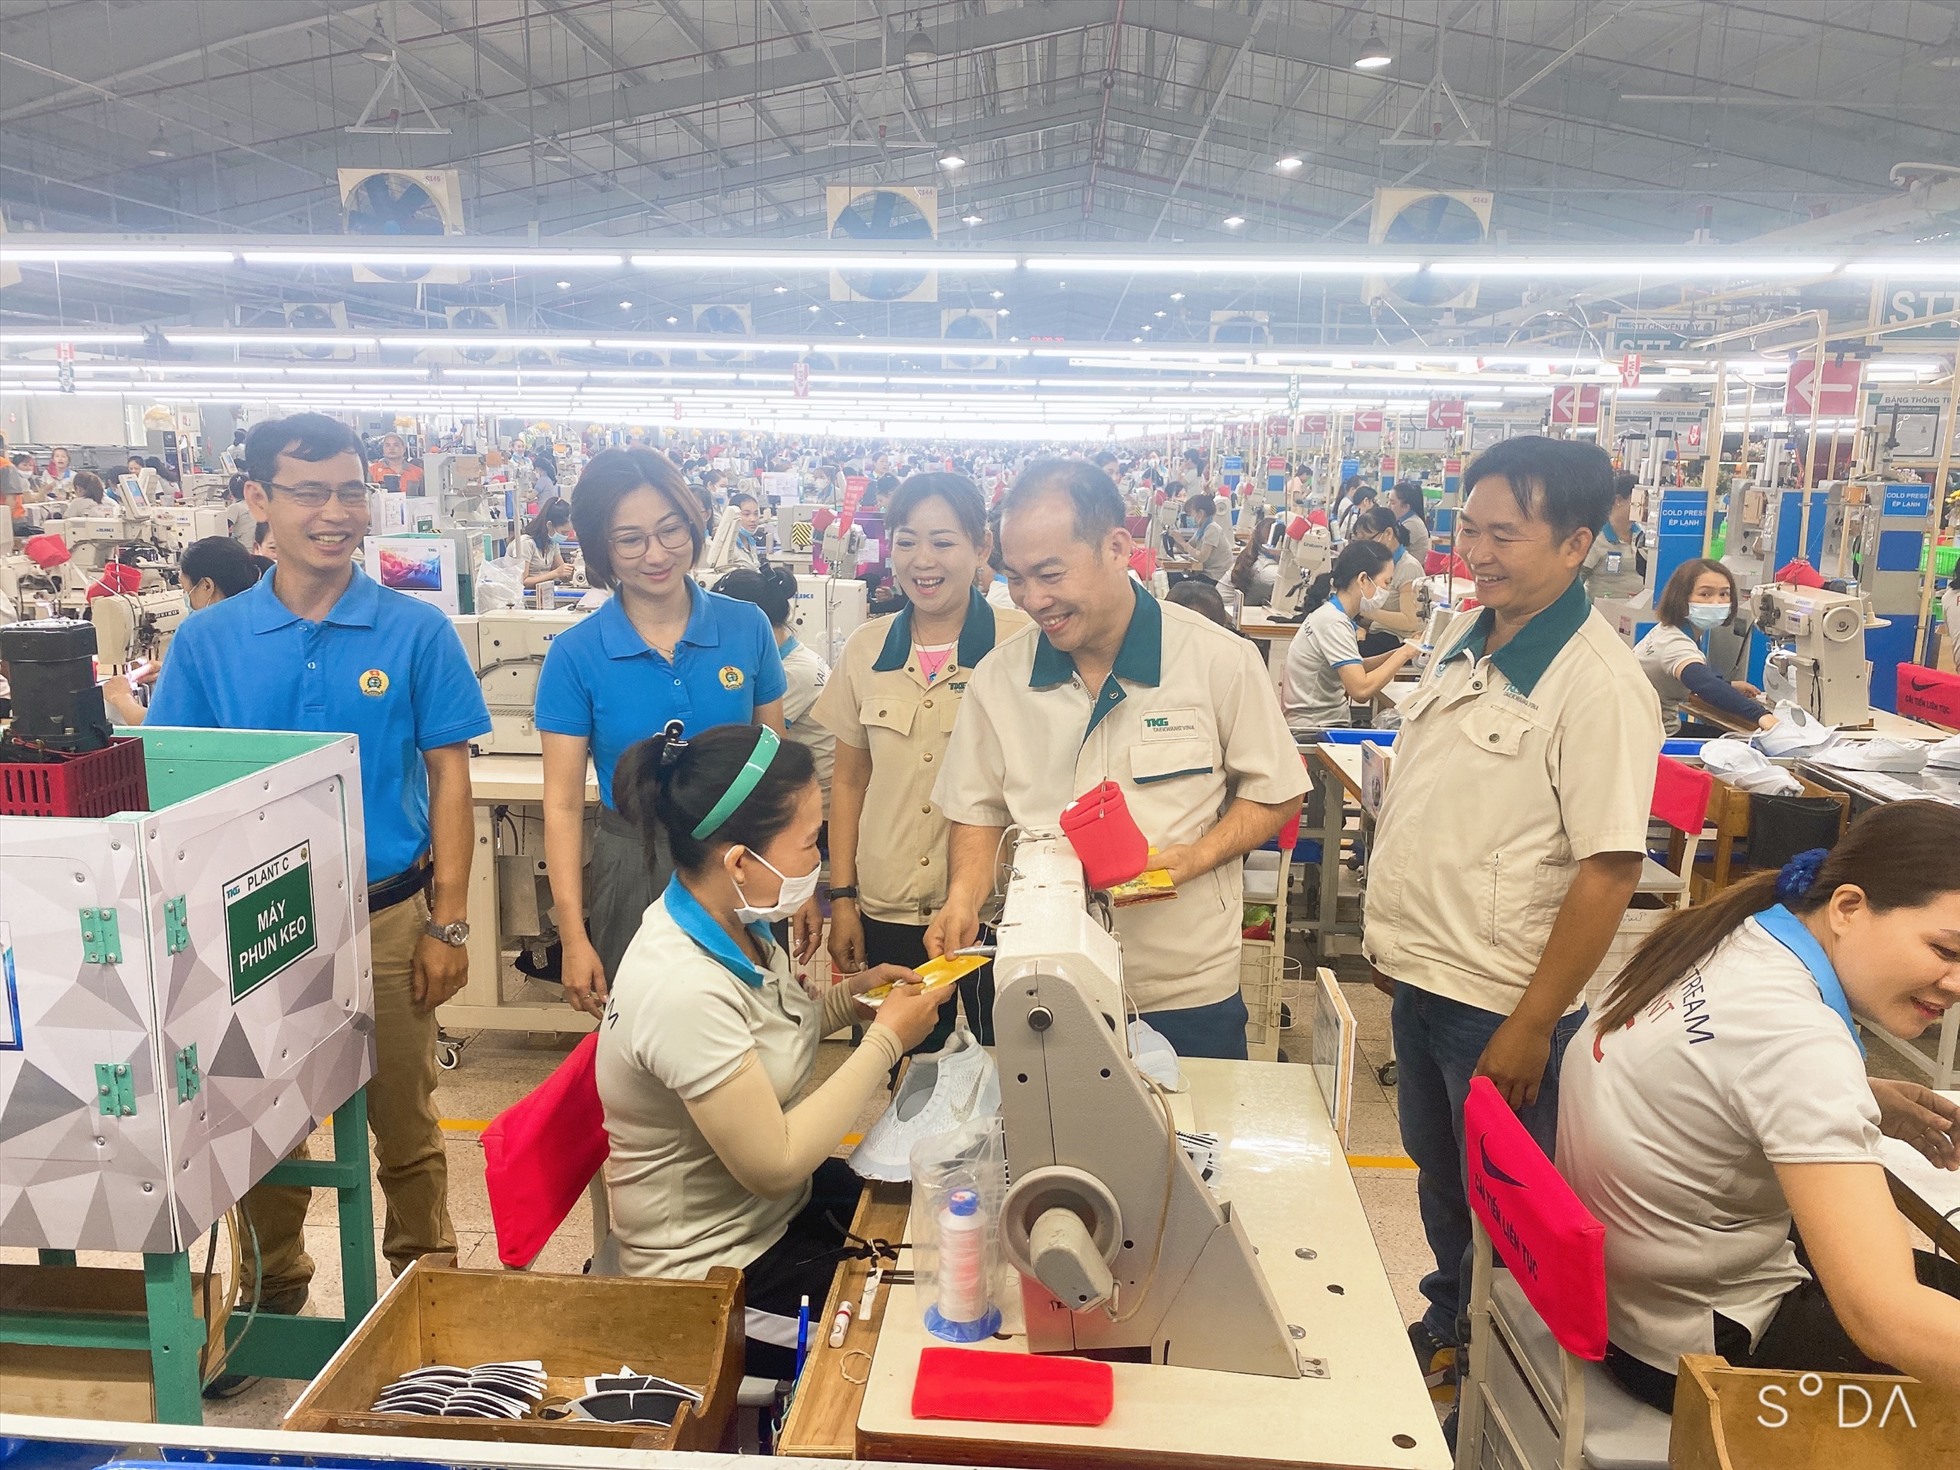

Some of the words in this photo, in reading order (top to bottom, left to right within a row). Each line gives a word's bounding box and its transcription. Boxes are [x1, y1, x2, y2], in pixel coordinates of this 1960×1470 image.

[1144, 717, 1169, 728] TKG
[226, 885, 241, 900] TKG
[247, 861, 280, 891] PLANT
[282, 856, 290, 871] C
[257, 899, 286, 933] MÁY
[239, 933, 278, 973] PHUN
[280, 915, 307, 947] KEO
